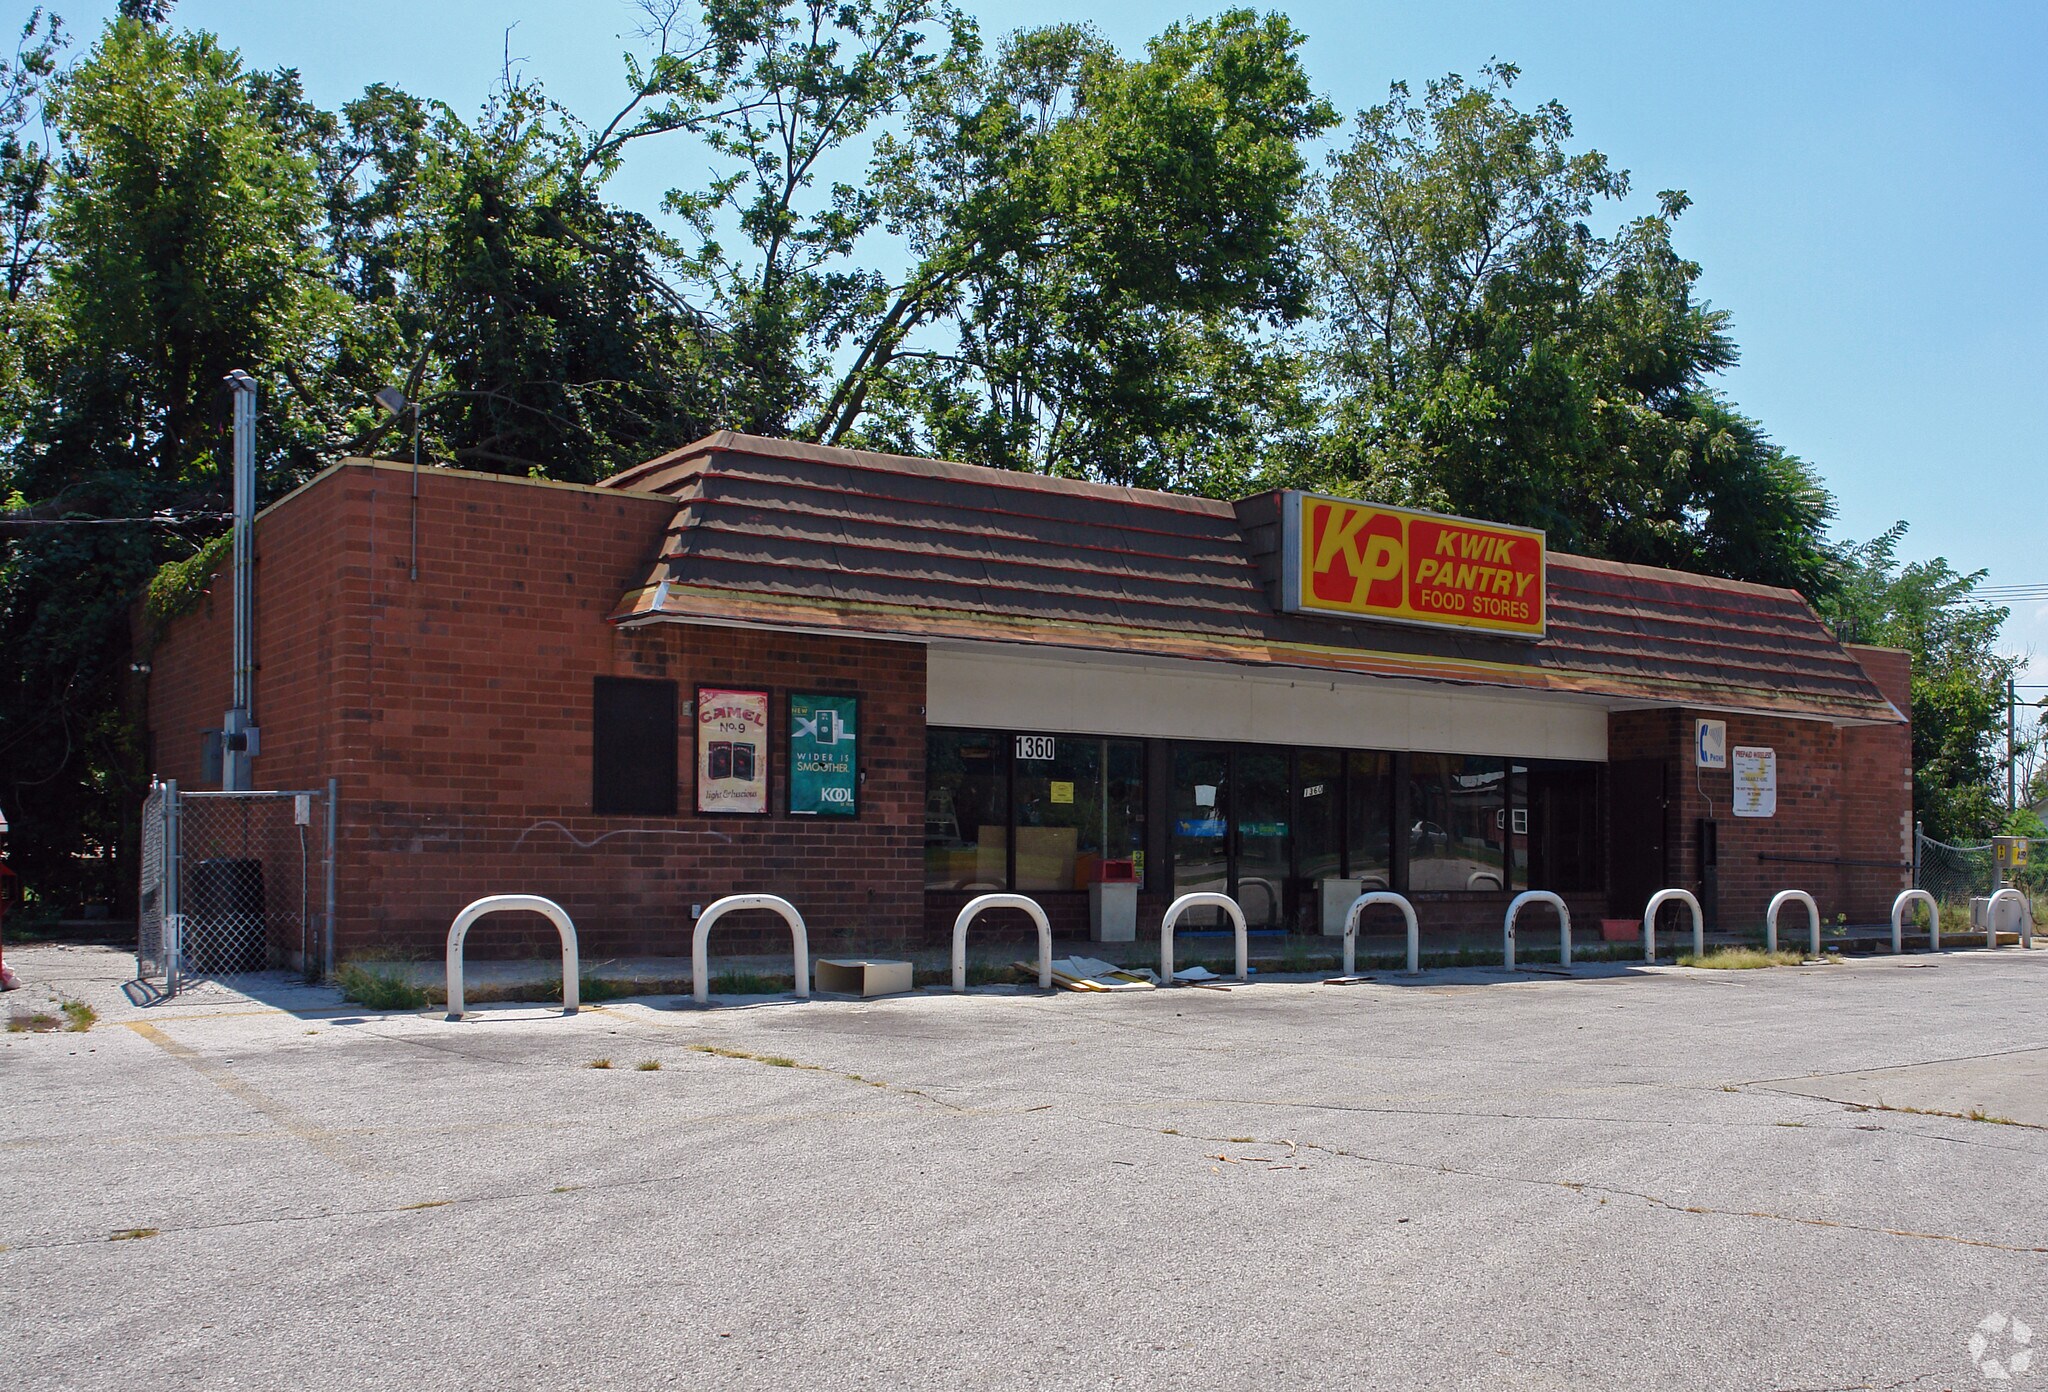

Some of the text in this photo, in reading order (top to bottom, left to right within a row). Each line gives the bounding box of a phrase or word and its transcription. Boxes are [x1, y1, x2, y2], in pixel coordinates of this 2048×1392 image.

[1313, 505, 1403, 605] KP
[1435, 530, 1517, 565] KWIK
[1415, 558, 1536, 598] PANTRY
[1421, 589, 1529, 619] FOOD STORES
[700, 707, 764, 727] CAMEL
[791, 707, 808, 715] NEW
[738, 722, 746, 733] 9
[1016, 736, 1054, 759] 1360
[797, 753, 849, 762] WIDER IS
[1710, 754, 1723, 762] PHONE
[705, 790, 722, 801] light
[821, 787, 855, 802] KOOL
[1303, 785, 1324, 798] 1360
